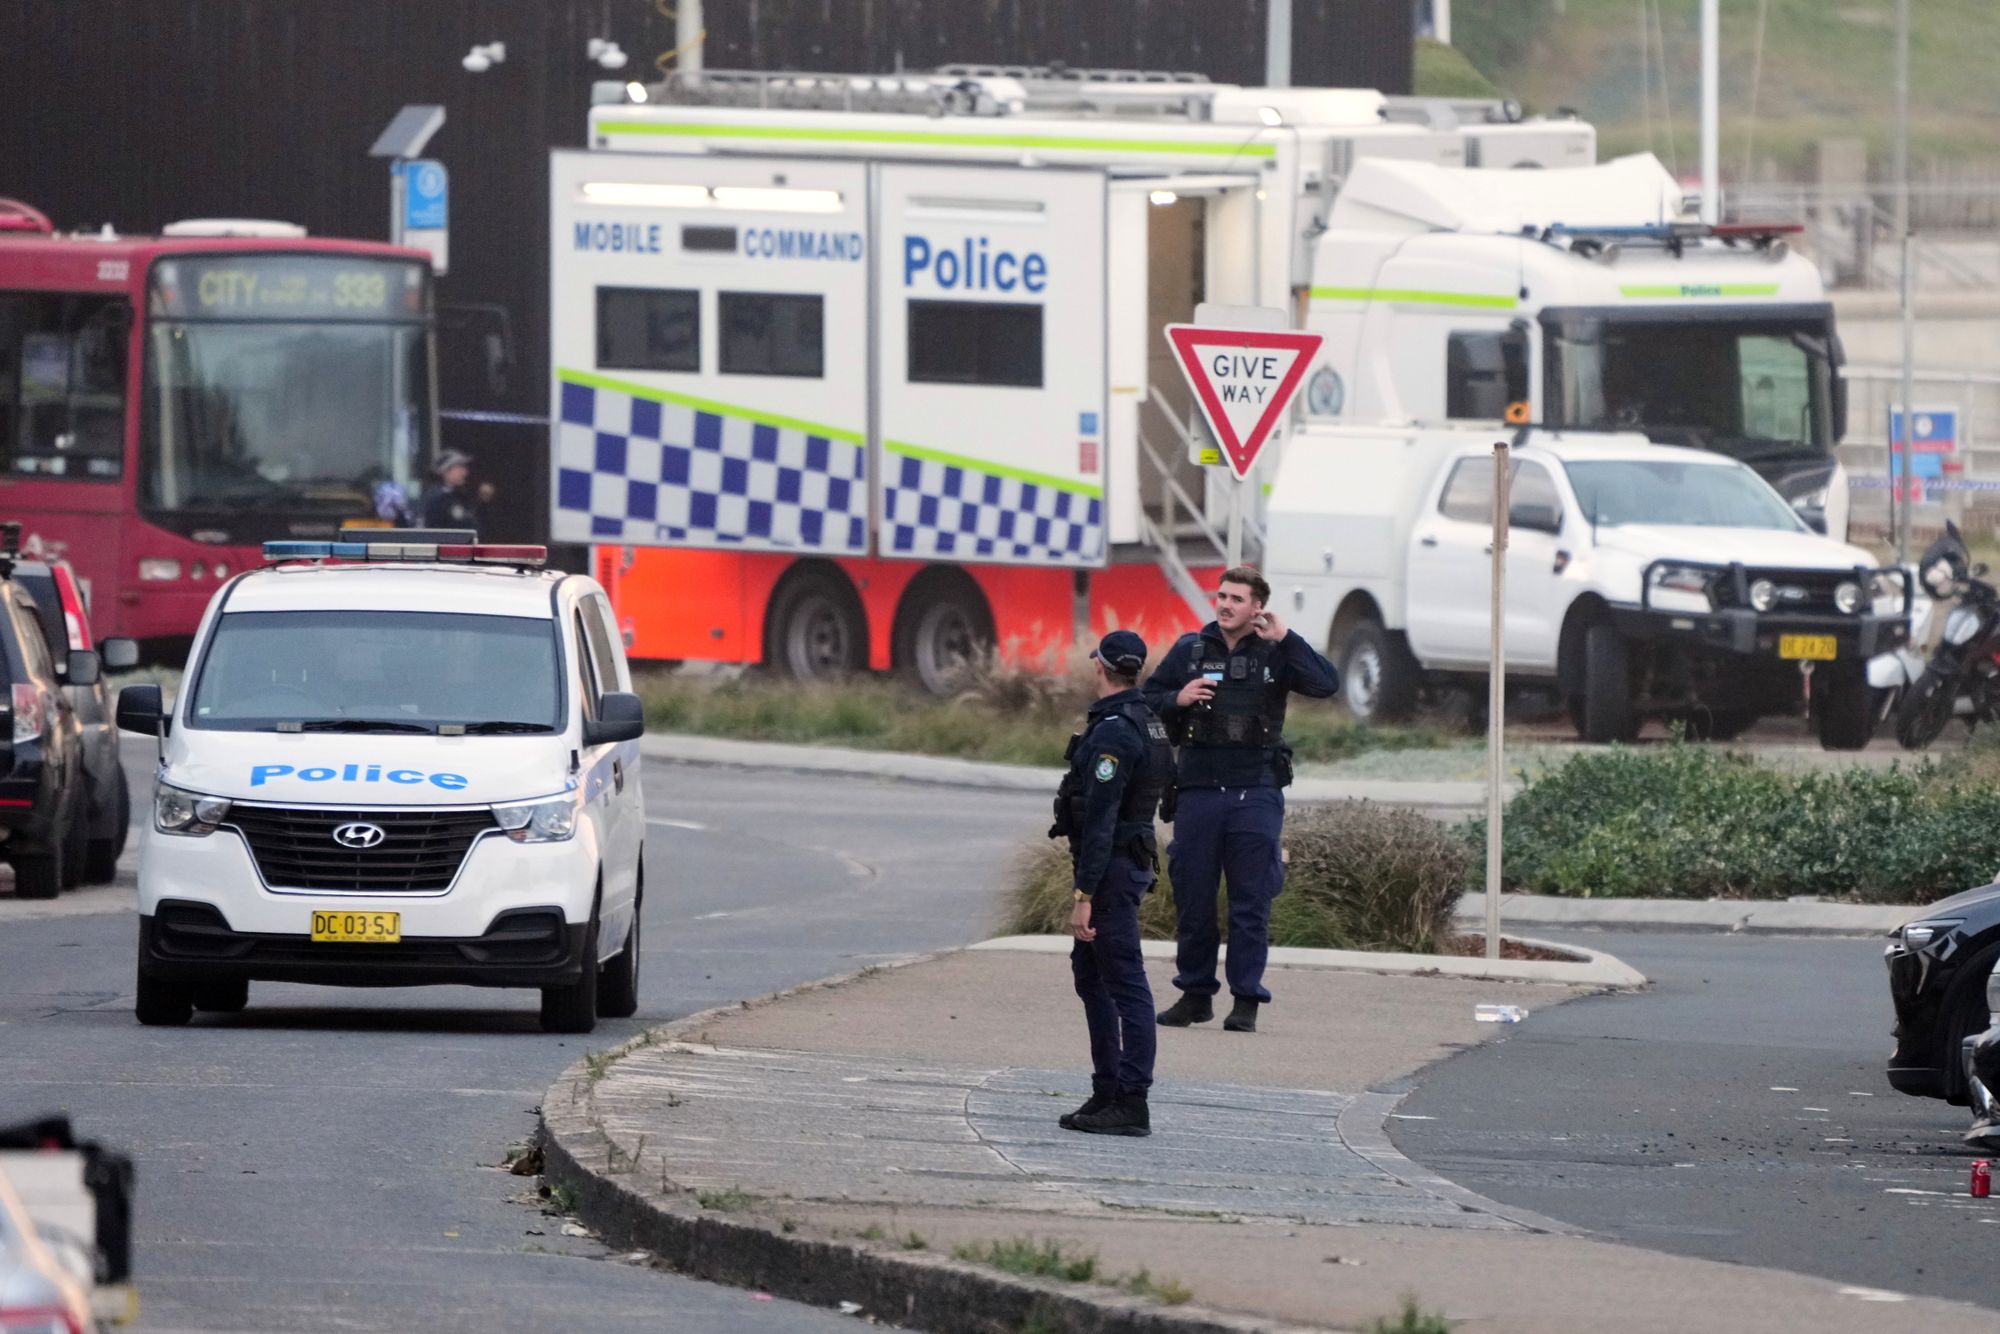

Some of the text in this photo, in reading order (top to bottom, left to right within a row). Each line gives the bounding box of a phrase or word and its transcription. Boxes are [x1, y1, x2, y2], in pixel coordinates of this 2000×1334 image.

[573, 220, 864, 262] MOBILE COMMAND
[903, 235, 1048, 293] Police
[198, 270, 257, 305] CITY
[1680, 283, 1722, 297] Police
[1213, 354, 1278, 380] GIVE
[1222, 384, 1267, 404] WAY
[249, 763, 468, 790] Police
